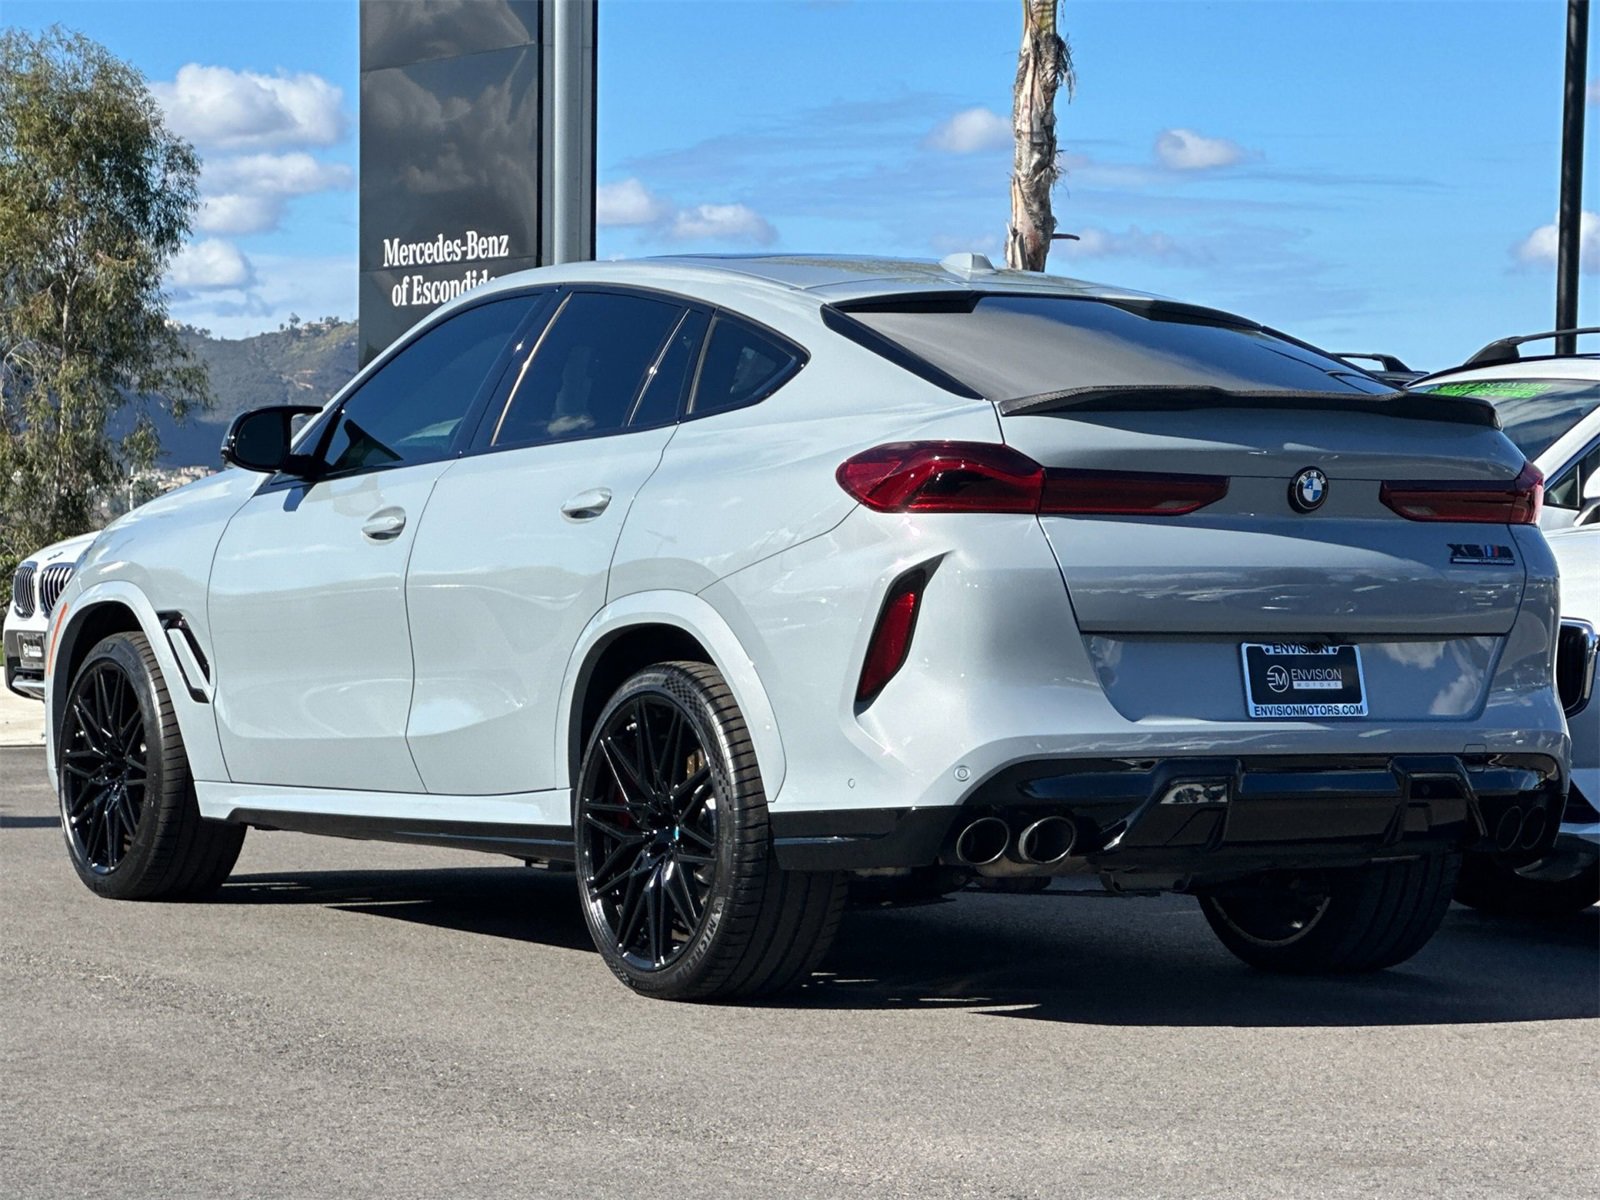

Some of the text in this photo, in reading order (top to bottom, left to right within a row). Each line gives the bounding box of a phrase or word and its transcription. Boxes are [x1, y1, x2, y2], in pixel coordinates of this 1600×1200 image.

[383, 230, 509, 267] Mercedes-Benz
[391, 269, 496, 307] of Escondi
[1291, 668, 1342, 680] ENVISION
[1254, 704, 1363, 717] ENVISIONMOTORS.COM
